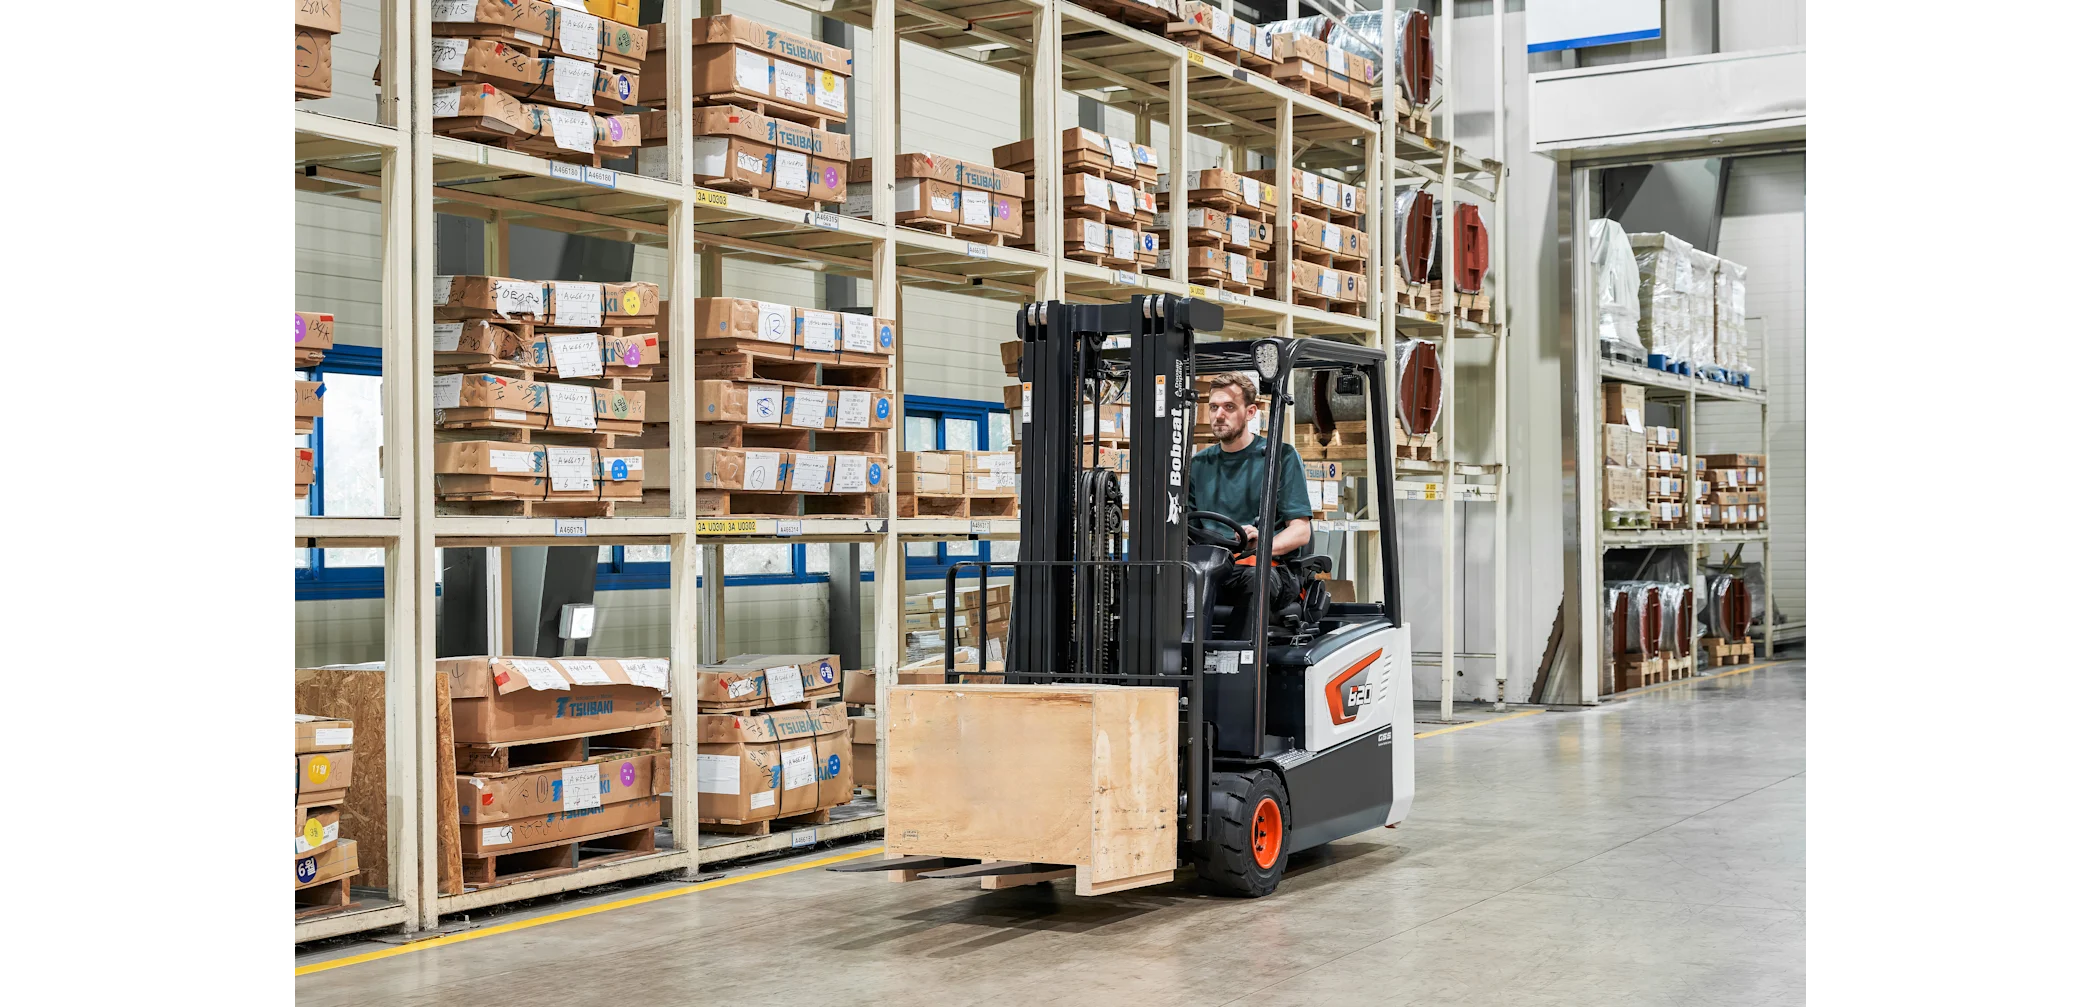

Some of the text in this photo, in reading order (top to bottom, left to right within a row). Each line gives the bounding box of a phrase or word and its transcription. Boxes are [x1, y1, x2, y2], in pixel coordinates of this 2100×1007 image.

[779, 41, 823, 64] TSUBAKI
[779, 130, 822, 153] TSUBAKI
[554, 165, 579, 176] A466180
[588, 170, 612, 182] A466180
[965, 172, 1001, 191] TSUBAKI
[697, 190, 728, 206] 3A U0303
[816, 210, 839, 224] A466315
[1169, 406, 1183, 487] Bobcat
[559, 526, 584, 534] A466179
[697, 522, 726, 532] 3A U0301
[727, 521, 756, 531] 3A U0302
[569, 700, 613, 717] TSUBAKI
[778, 719, 823, 735] TSUBAKI
[312, 764, 327, 775] 11월
[297, 857, 316, 878] 6월
